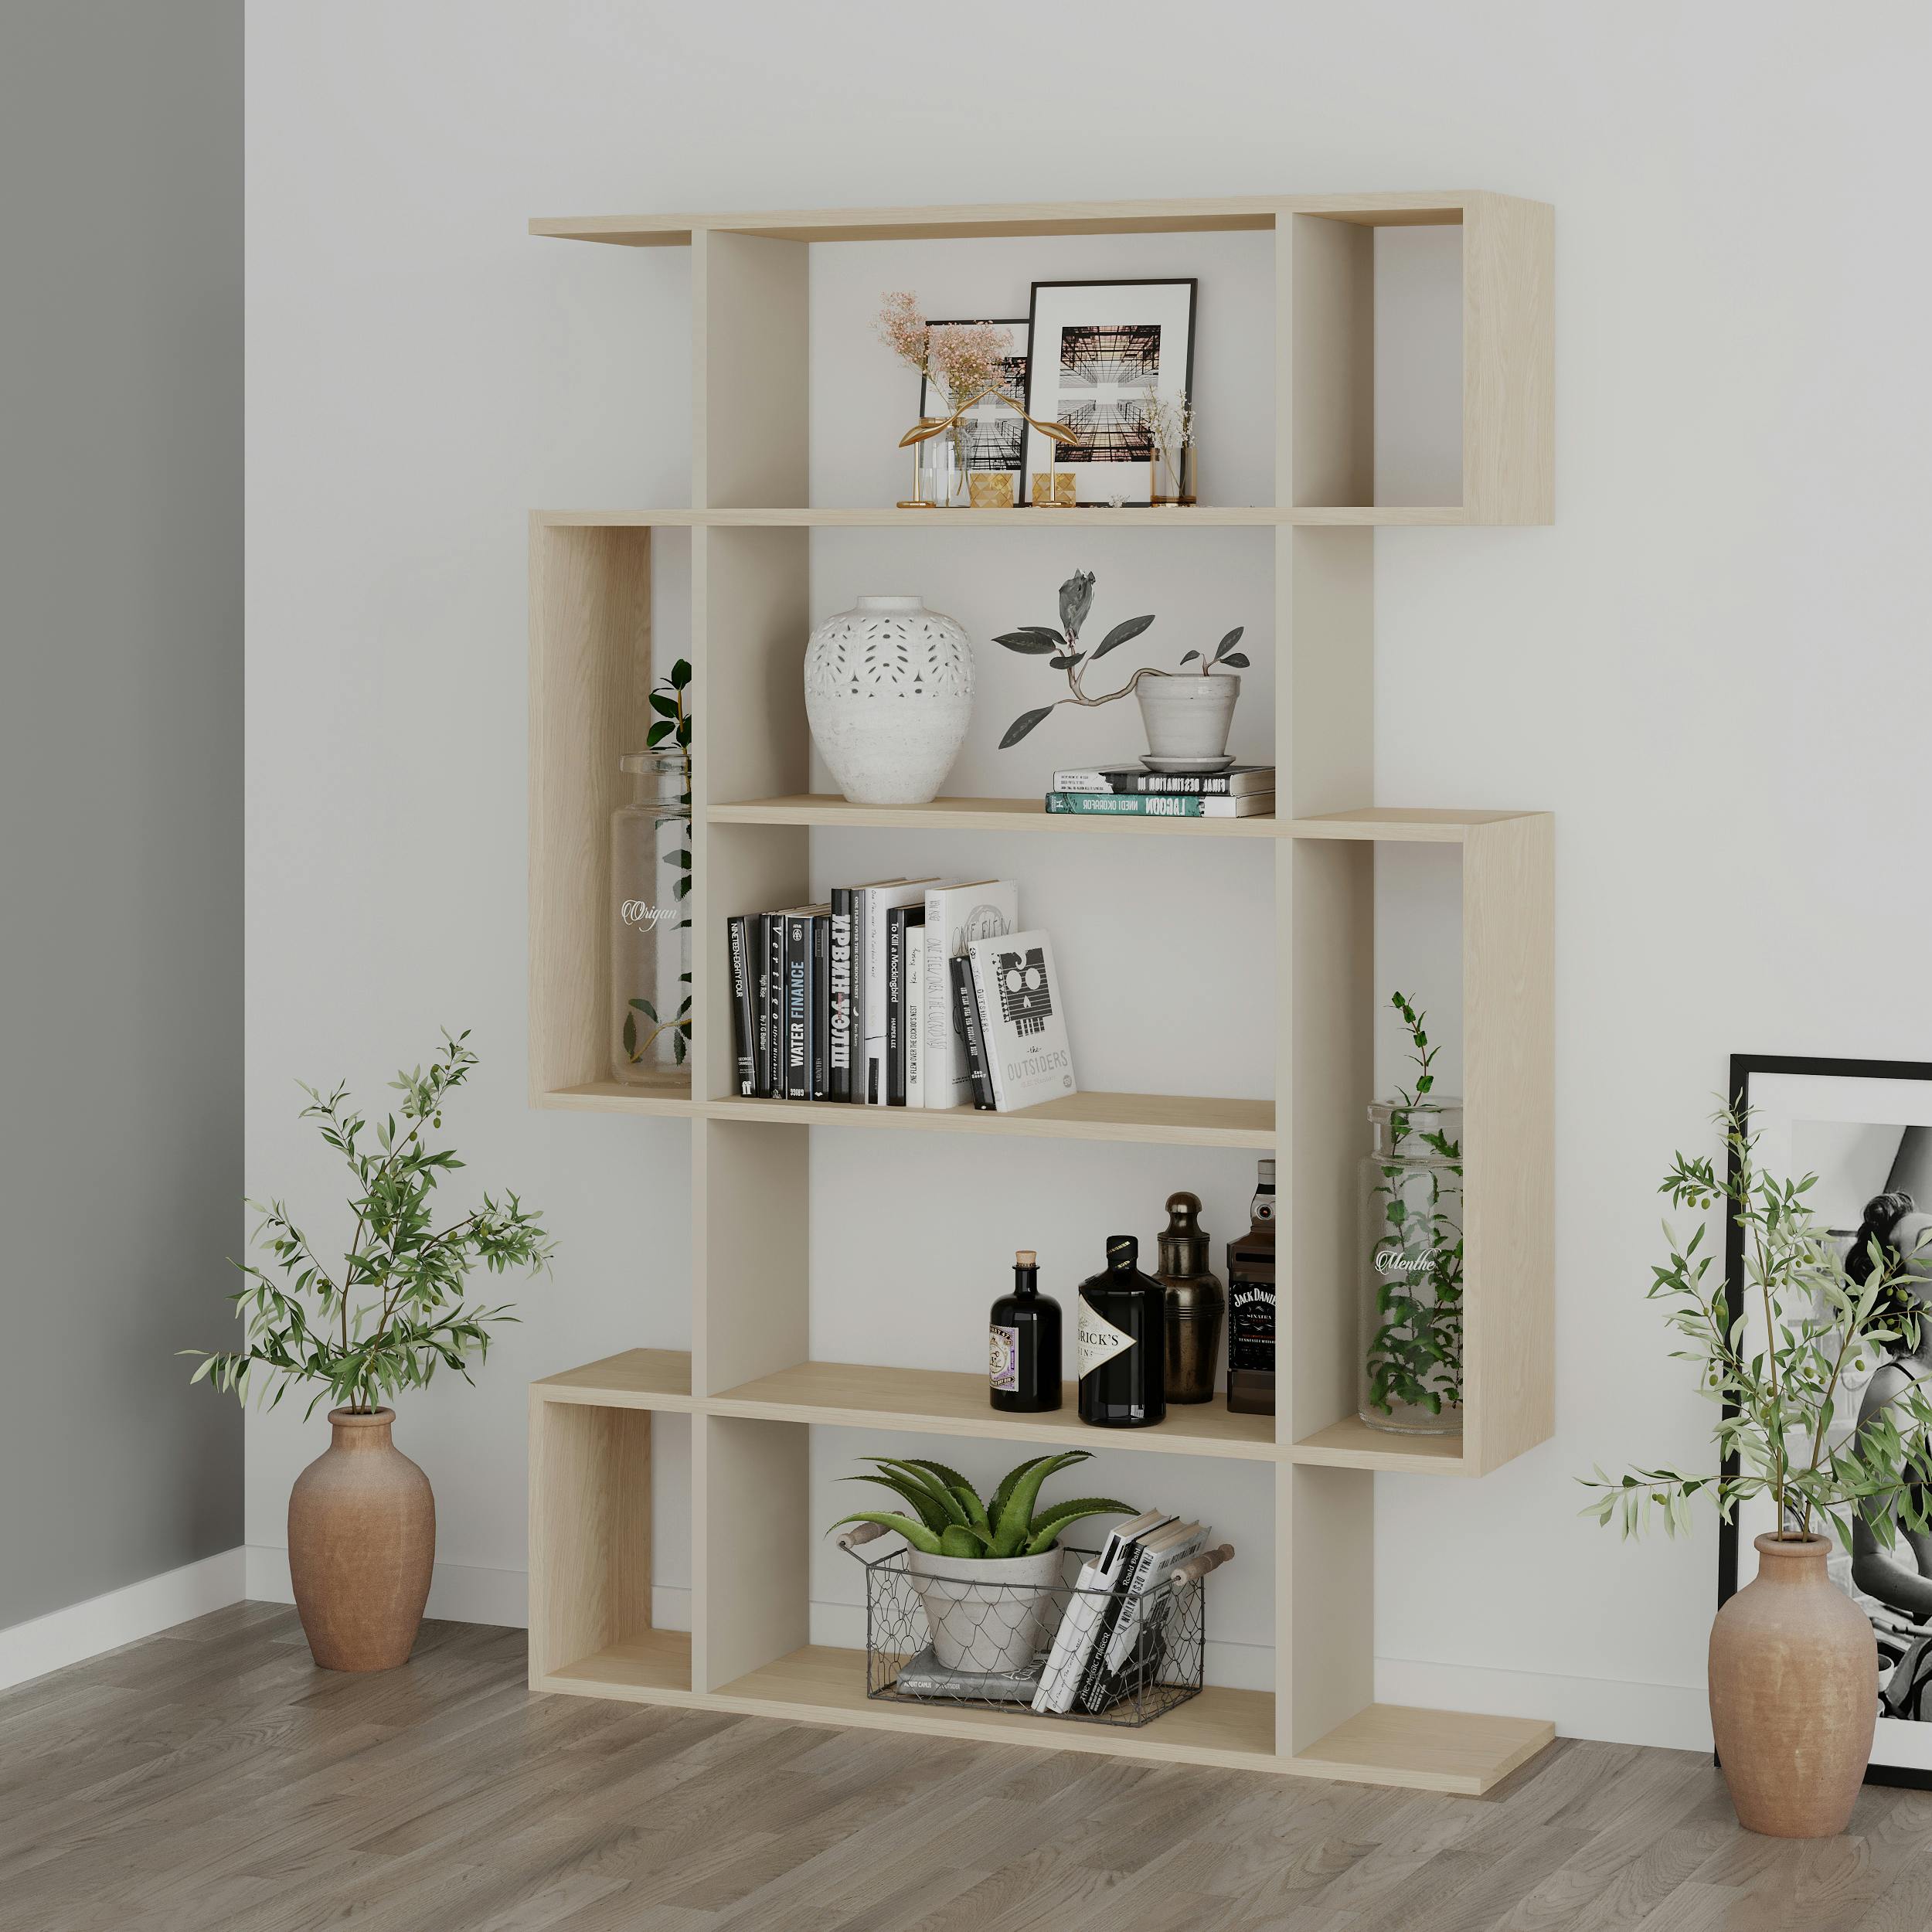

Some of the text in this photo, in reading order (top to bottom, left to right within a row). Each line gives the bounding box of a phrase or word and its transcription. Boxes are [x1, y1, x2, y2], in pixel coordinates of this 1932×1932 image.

[621, 900, 677, 932] Origan
[892, 923, 899, 932] To
[731, 923, 742, 979] NINETEEN-EIGHTY
[772, 926, 782, 1020] Vertigo
[831, 913, 851, 1069] ИРВИН УЭЛШ
[889, 954, 899, 1003] Mockingbird
[791, 961, 804, 1067] WATER FINANCE
[976, 988, 989, 1032] OUTSIDERS
[1007, 1049, 1068, 1081] OUTSIDERS
[1375, 1247, 1442, 1275] Menthe
[1234, 1291, 1253, 1308] JACK
[1123, 1548, 1141, 1587] Roald Dahl
[1139, 1553, 1154, 1573] FINAL
